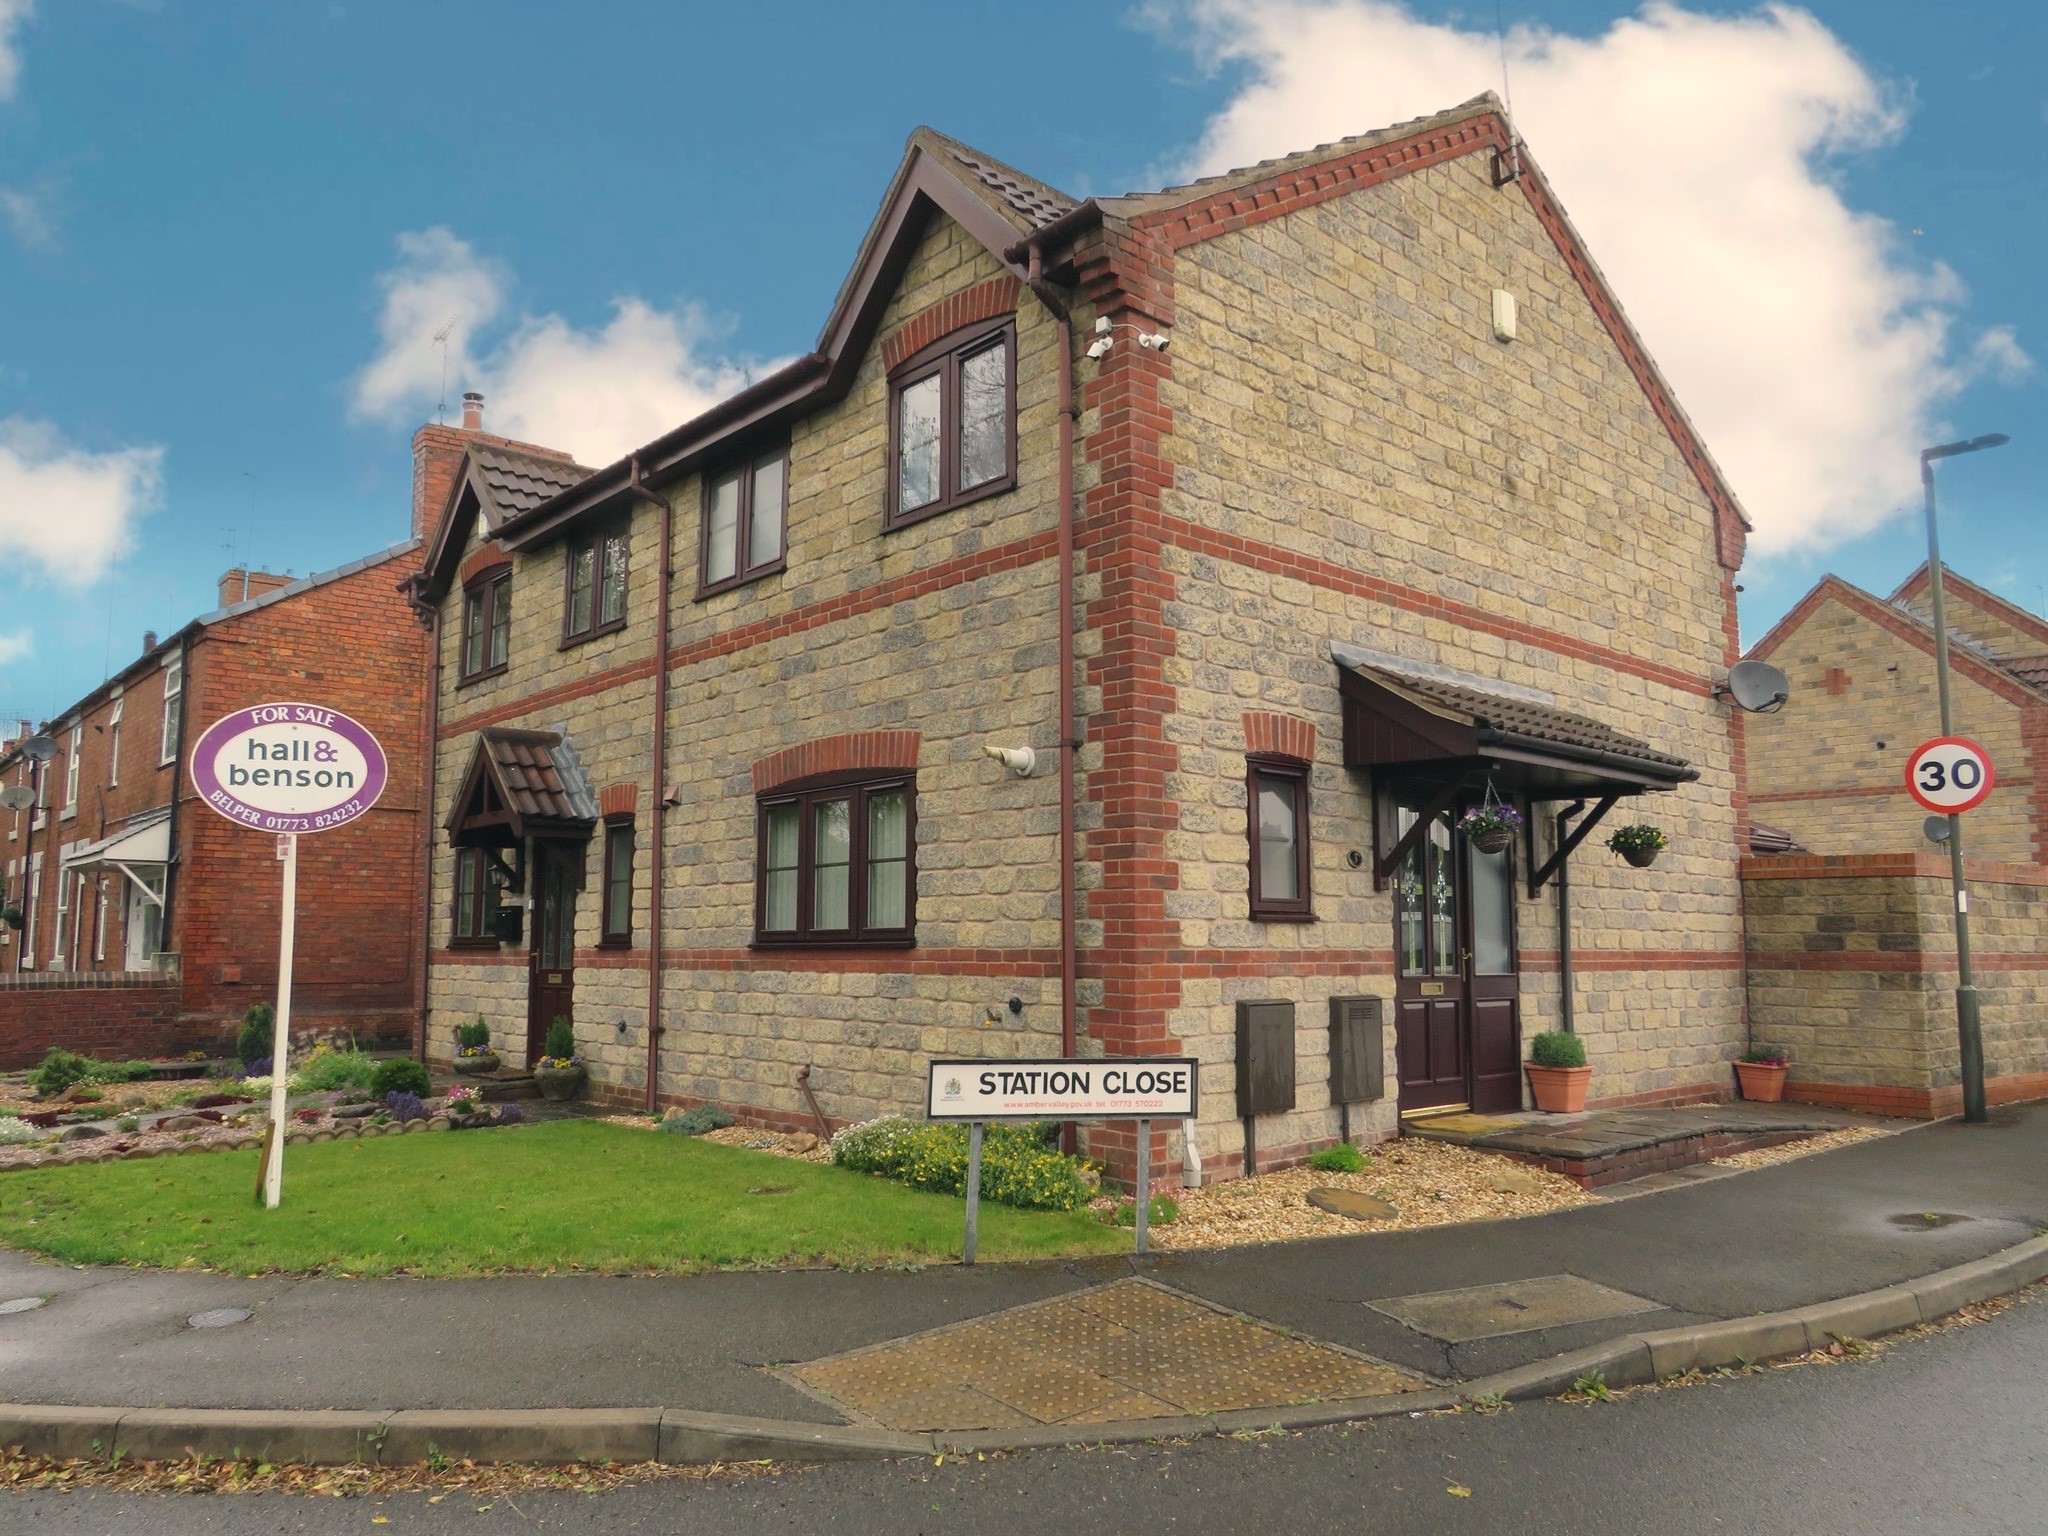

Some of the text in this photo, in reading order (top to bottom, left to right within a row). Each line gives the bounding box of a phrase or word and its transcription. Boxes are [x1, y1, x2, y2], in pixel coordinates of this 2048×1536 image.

[251, 707, 336, 728] FOR SALE
[248, 738, 338, 763] hall&
[229, 763, 354, 788] benson
[1919, 758, 1981, 792] 30
[209, 789, 363, 831] BELPER 01773 824232
[978, 1071, 1187, 1095] STATION CLOSE
[1110, 1100, 1132, 1108] 01773
